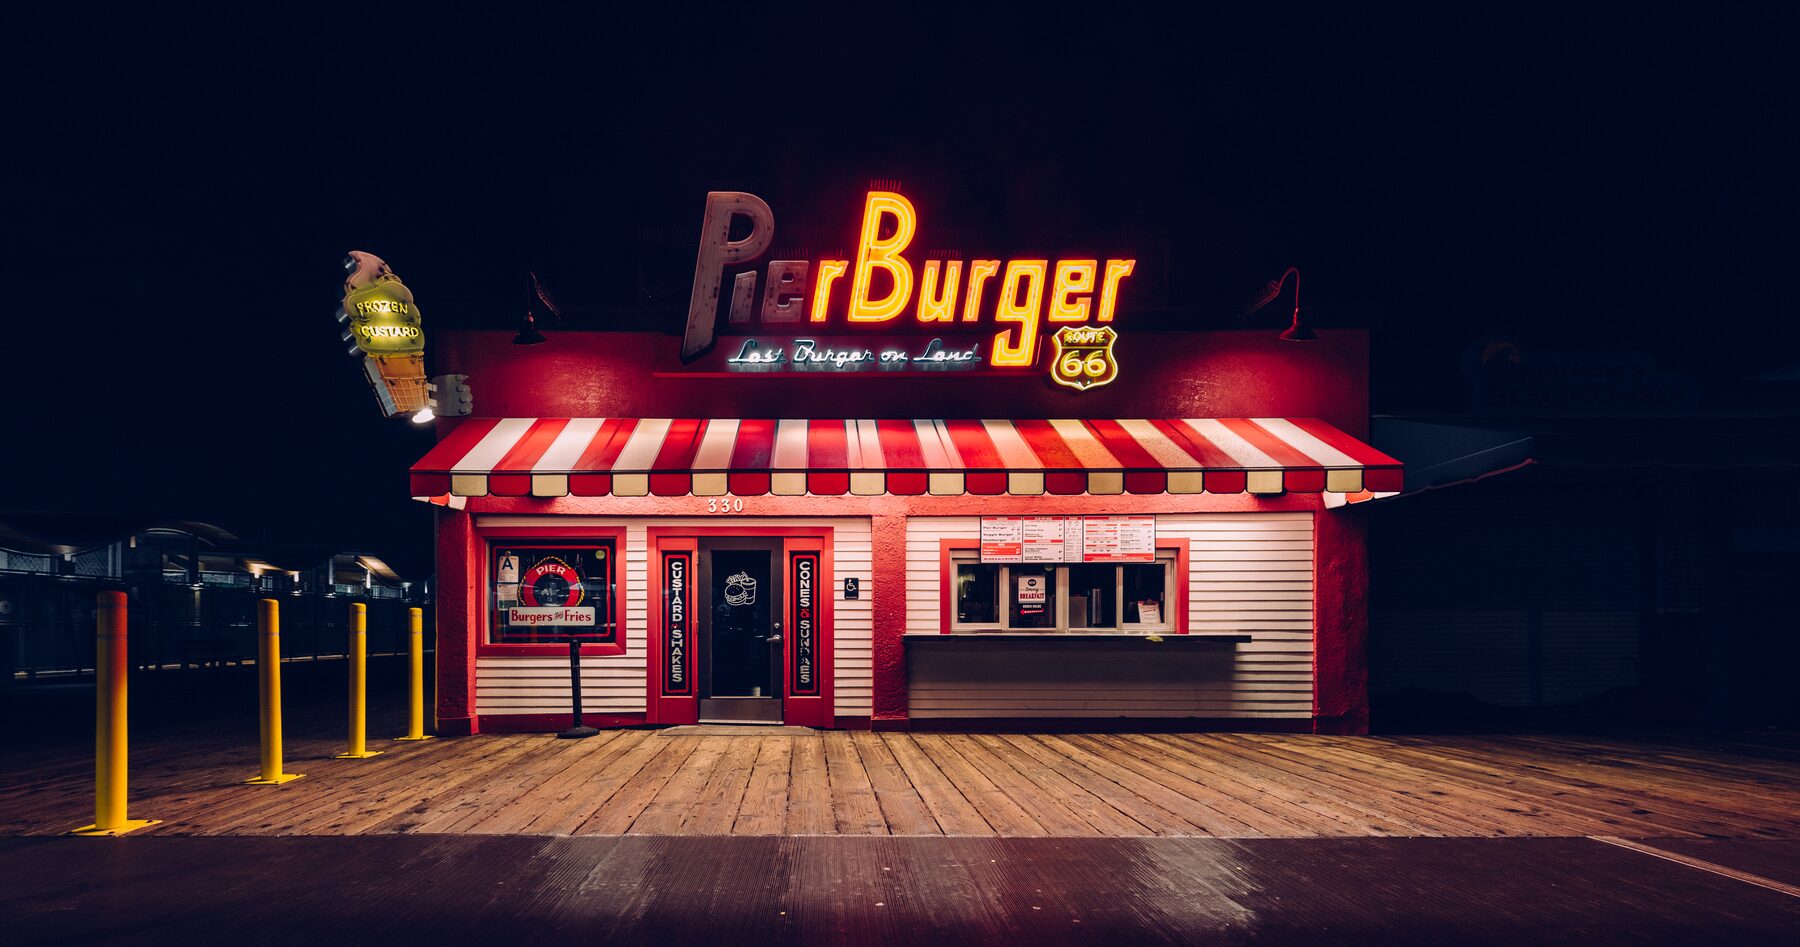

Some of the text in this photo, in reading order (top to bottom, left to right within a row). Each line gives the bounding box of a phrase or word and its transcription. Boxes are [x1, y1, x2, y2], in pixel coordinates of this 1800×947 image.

[355, 300, 408, 318] FROZEN
[361, 325, 419, 338] CUSTARD
[1064, 331, 1106, 344] ROUTE
[793, 339, 874, 369] Burger
[879, 351, 908, 363] on
[912, 338, 982, 363] Land
[1060, 350, 1106, 377] 66
[708, 498, 743, 512] 330
[502, 557, 513, 570] A
[536, 564, 566, 576] PIER
[671, 561, 683, 622] CUSTARD
[799, 561, 811, 608] CONES
[511, 609, 553, 624] Burgers
[564, 609, 592, 622] Fries
[671, 630, 683, 683] SHAKES
